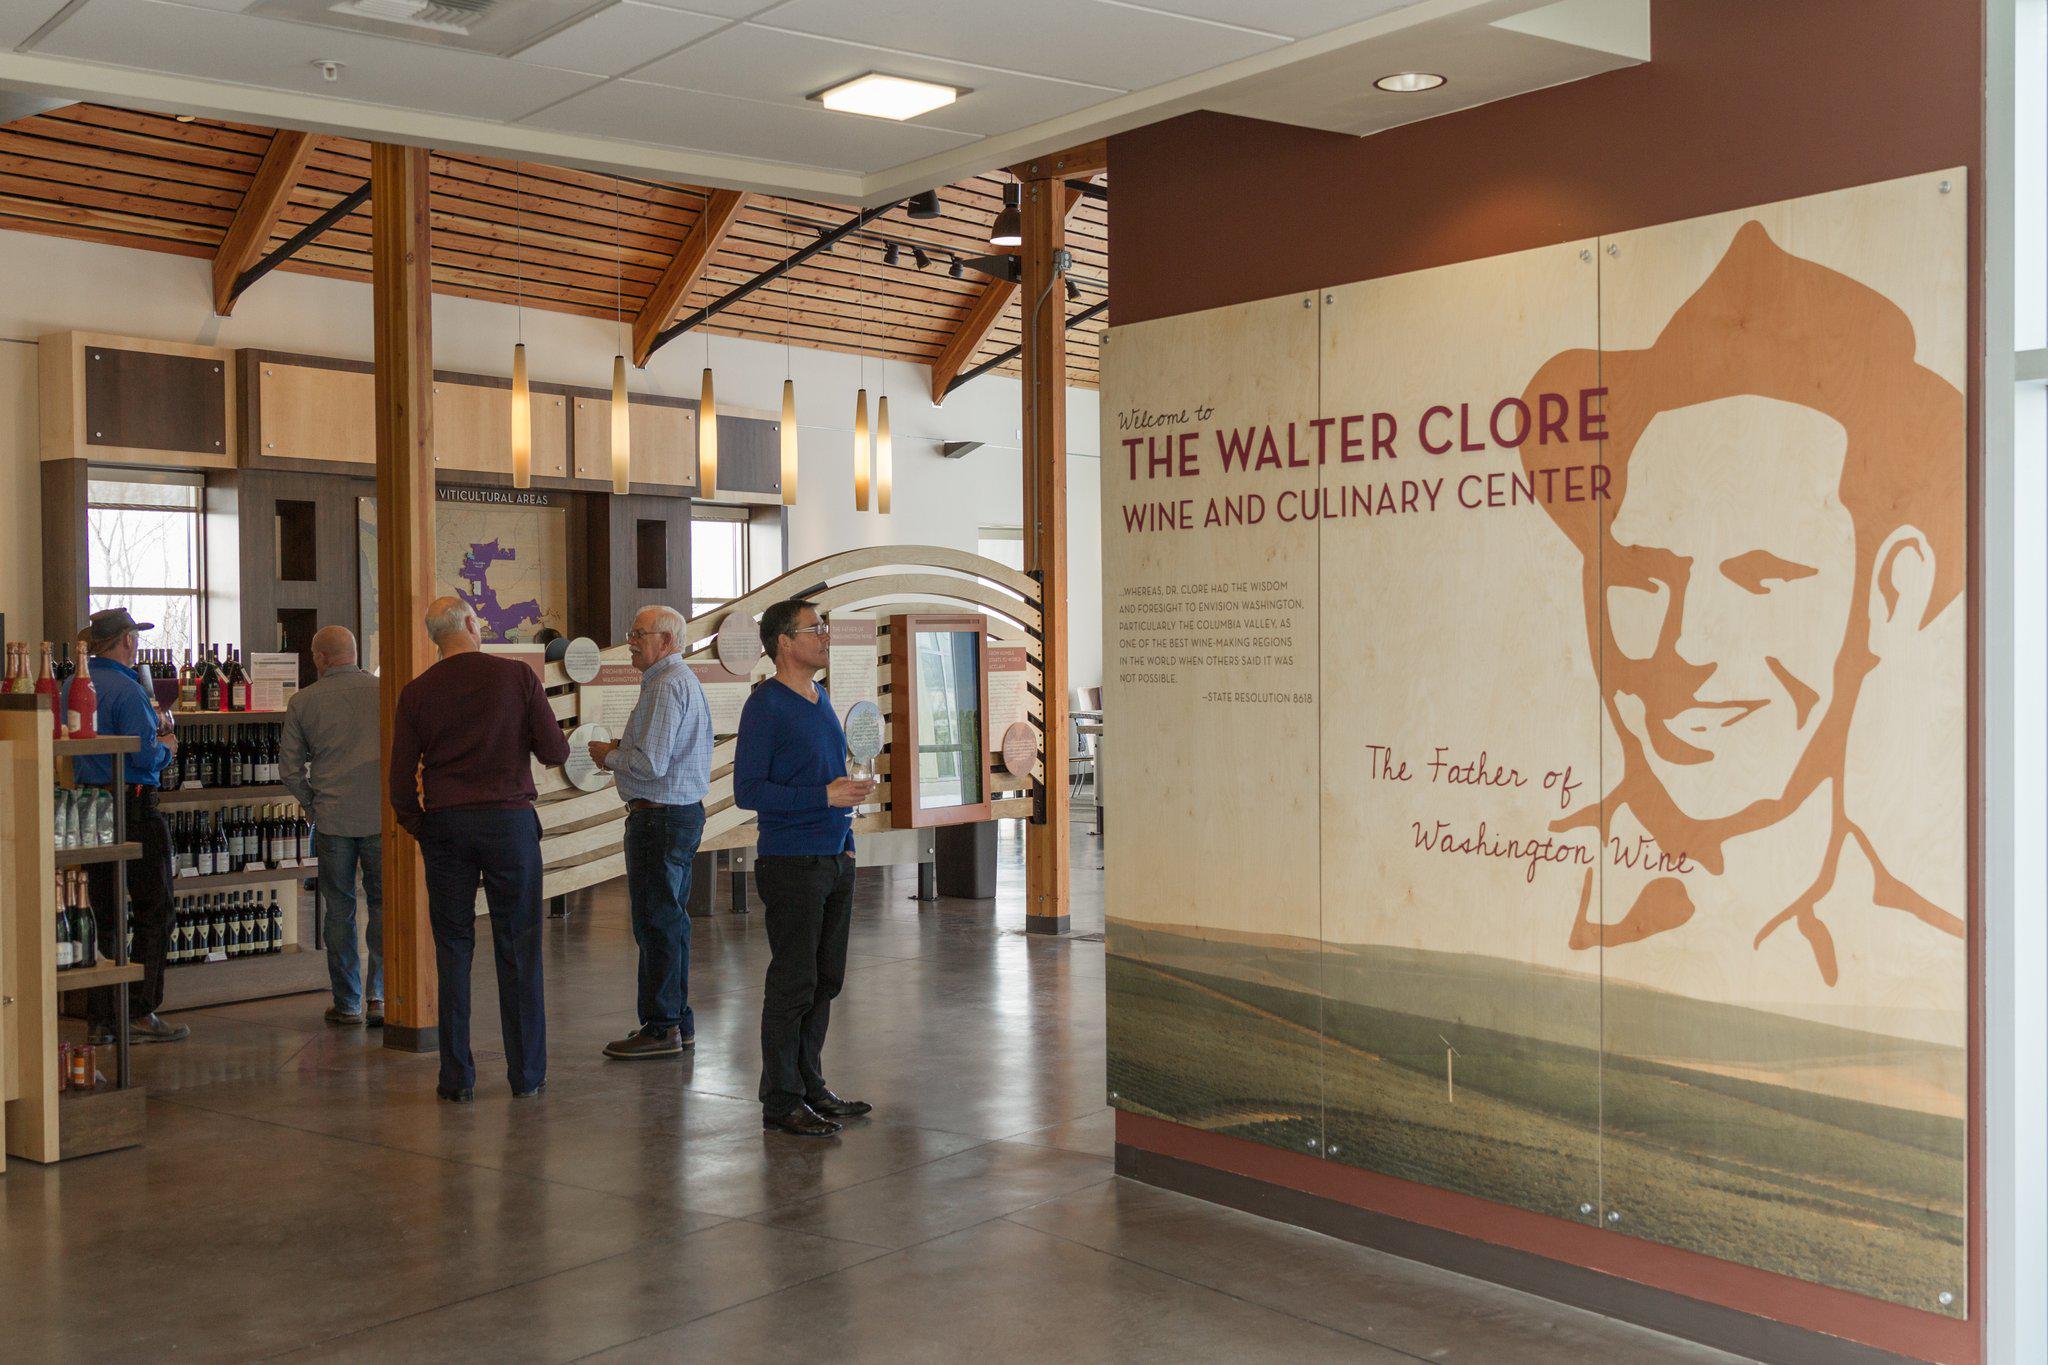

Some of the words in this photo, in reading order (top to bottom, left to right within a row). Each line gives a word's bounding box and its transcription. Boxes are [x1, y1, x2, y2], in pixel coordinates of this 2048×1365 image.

[1118, 408, 1190, 431] Welcome
[1194, 405, 1215, 422] to
[1121, 431, 1200, 481] THE
[1215, 412, 1398, 474] WALTER
[1418, 387, 1610, 455] CLORE
[438, 488, 515, 504] VITICULTURAL
[516, 493, 549, 506] AREAS
[1122, 500, 1194, 534] WINE
[1203, 494, 1266, 528] AND
[1276, 477, 1444, 523] CULINARY
[1457, 464, 1612, 509] CENTER
[1165, 585, 1179, 596] DR.
[1180, 584, 1209, 595] CLORE
[1210, 583, 1229, 593] HAD
[1231, 582, 1248, 592] THE
[1250, 580, 1288, 592] WISDOM
[1119, 604, 1136, 614] AND
[1137, 602, 1183, 614] FORESIGHT
[1184, 602, 1196, 612] TO
[1198, 601, 1239, 612] ENVISION
[1119, 621, 1176, 631] PARTICULARLY
[1179, 620, 1195, 630] THE
[1196, 619, 1241, 630] COLUMBIA
[1280, 618, 1292, 628] AS
[1119, 638, 1137, 649] ONE
[1138, 638, 1150, 649] OF
[1151, 638, 1168, 648] THE
[1169, 638, 1189, 648] BEST
[1191, 637, 1251, 648] WINE-MAKING
[1252, 637, 1293, 647] REGIONS
[1119, 656, 1128, 666] IN
[1129, 656, 1145, 666] THE
[1146, 656, 1177, 666] WORLD
[1178, 656, 1204, 666] WHEN
[1206, 656, 1239, 666] OTHERS
[1241, 656, 1262, 666] SAID
[1263, 656, 1272, 666] IT
[1274, 656, 1294, 666] WAS
[1119, 673, 1136, 683] NOT
[1138, 673, 1178, 684] POSSIBLE.
[1234, 692, 1291, 703] RESOLUTION
[1293, 693, 1313, 704] 8618
[1365, 744, 1413, 782] The
[1427, 747, 1528, 787] Father
[1543, 765, 1583, 809] of
[1412, 821, 1595, 883] Washington
[1611, 836, 1694, 874] Wine
